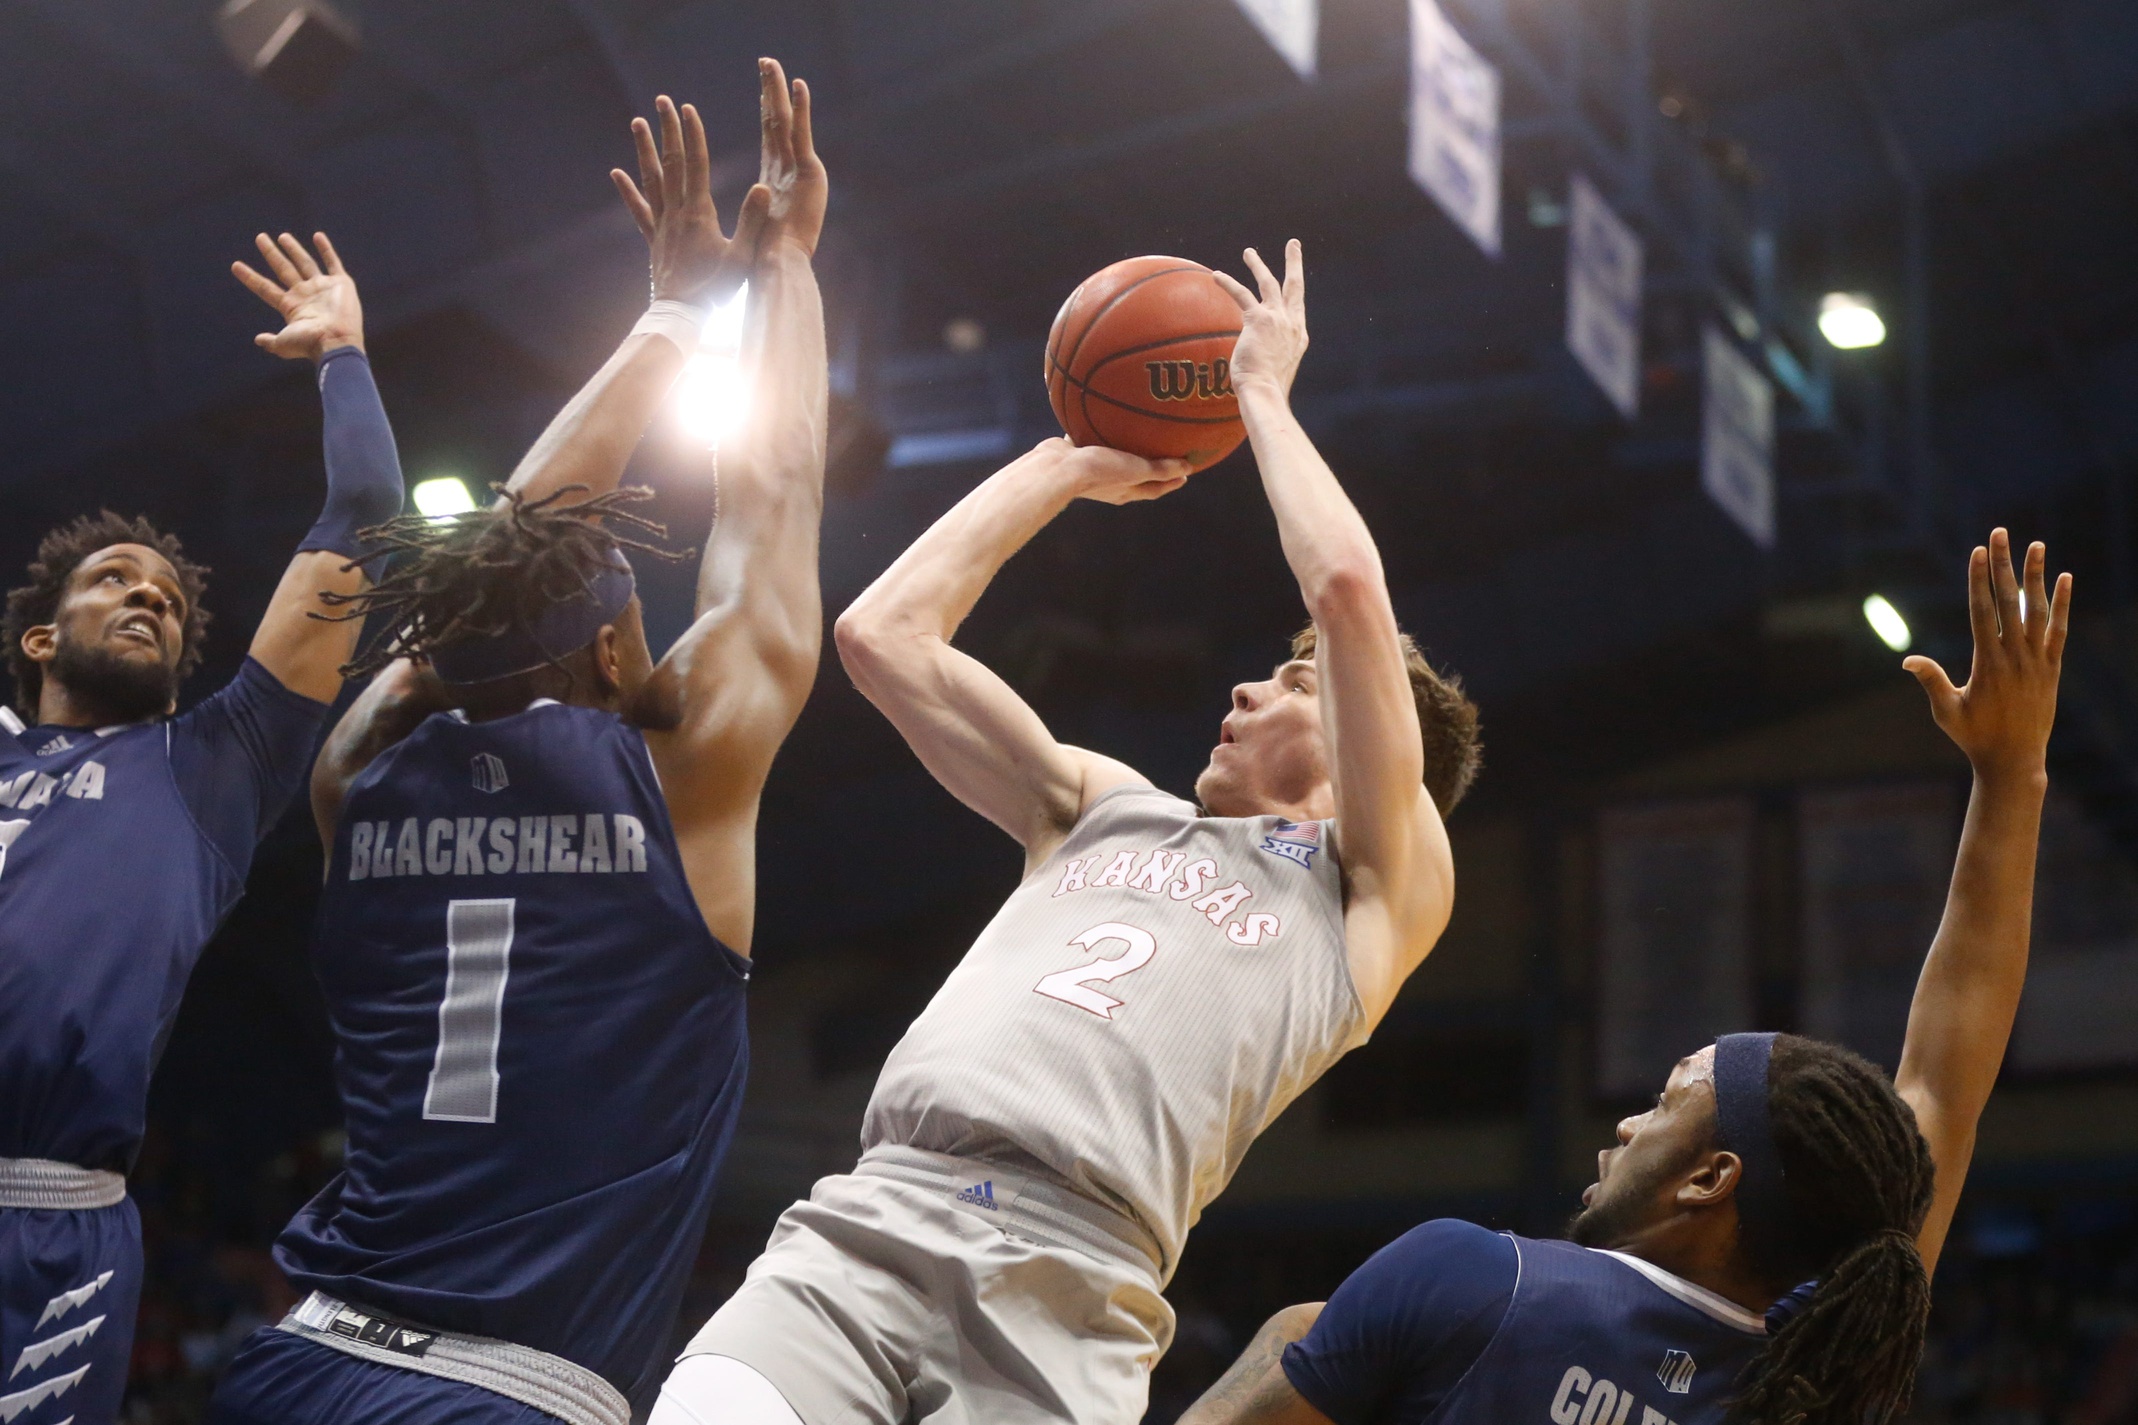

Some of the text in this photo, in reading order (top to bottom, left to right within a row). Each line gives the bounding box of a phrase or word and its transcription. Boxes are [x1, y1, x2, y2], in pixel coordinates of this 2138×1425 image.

[1144, 357, 1237, 401] Wil
[349, 813, 647, 880] BLACKSHEAR
[1052, 849, 1281, 946] KANSAS
[422, 898, 516, 1124] 1
[1032, 921, 1157, 1020] 2
[956, 1192, 999, 1211] adidas
